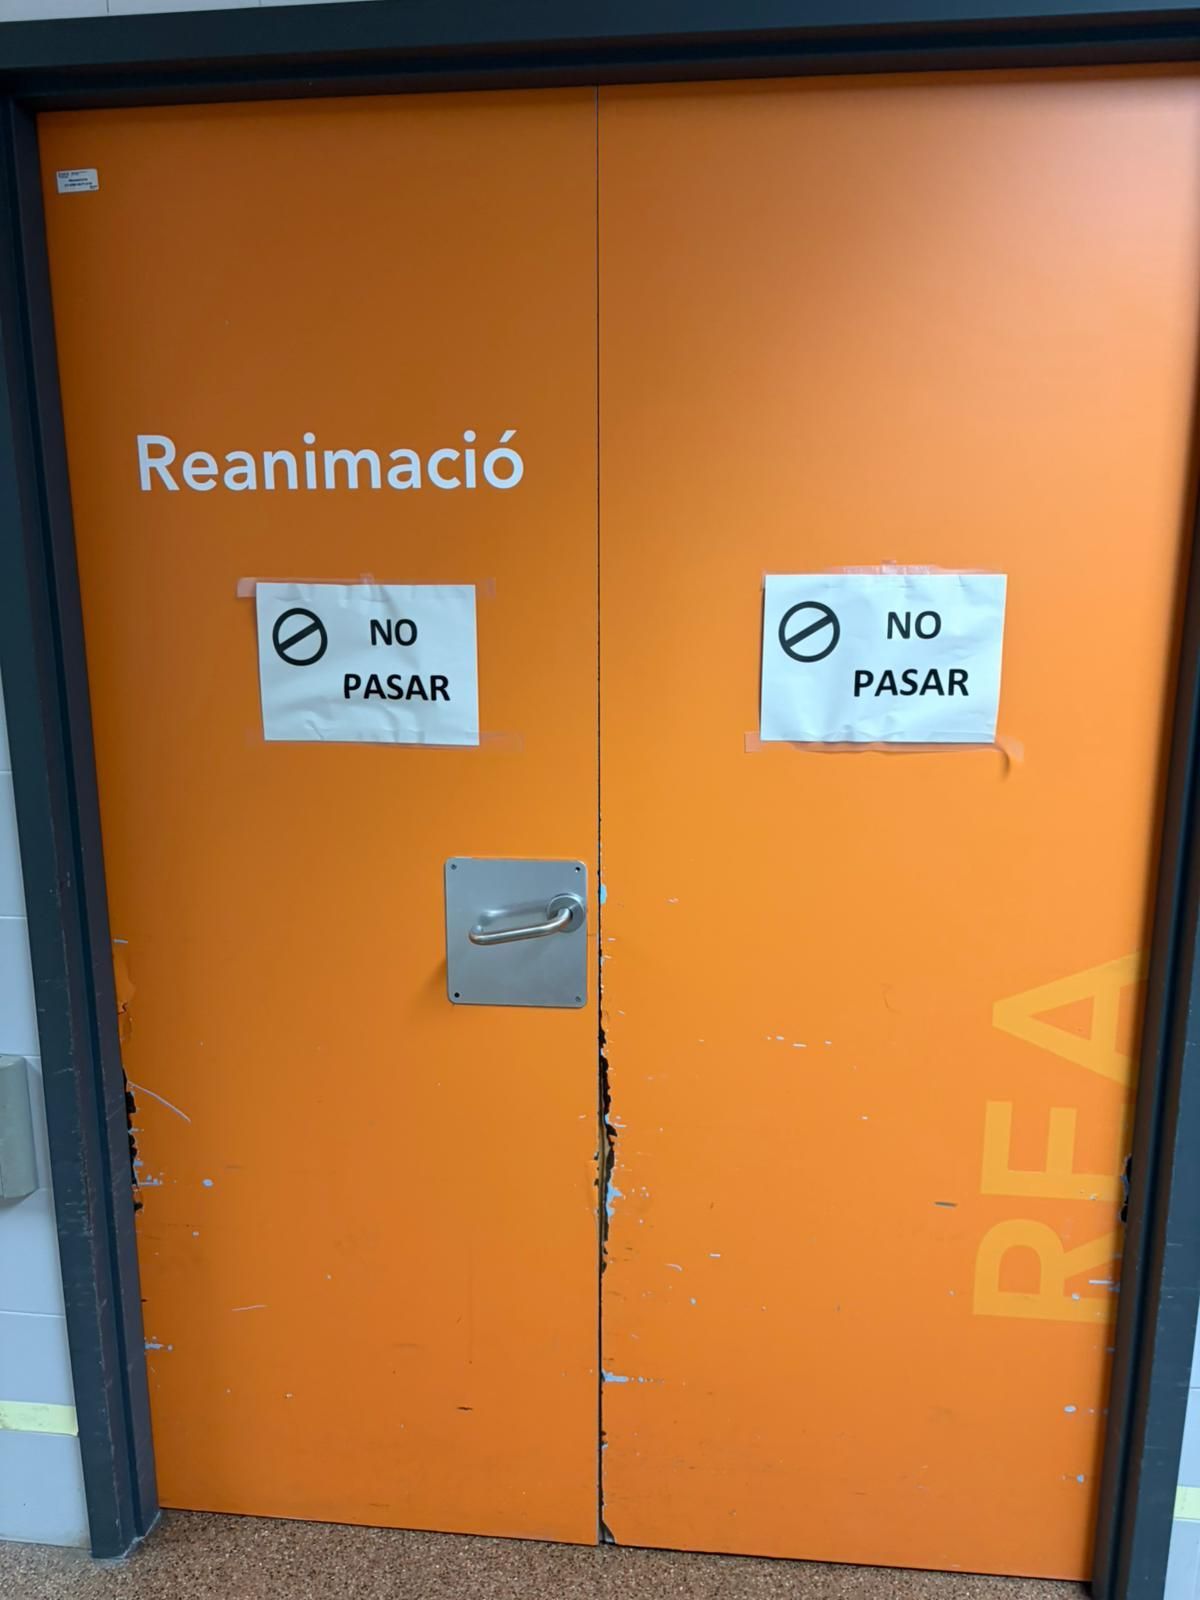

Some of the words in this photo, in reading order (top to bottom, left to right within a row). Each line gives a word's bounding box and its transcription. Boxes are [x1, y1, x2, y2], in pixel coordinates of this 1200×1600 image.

[137, 429, 524, 492] Reanimació
[370, 619, 418, 647] NO
[888, 611, 941, 640] NO
[344, 674, 450, 702] PASAR
[854, 668, 969, 697] PASAR
[973, 950, 1141, 1324] REA
